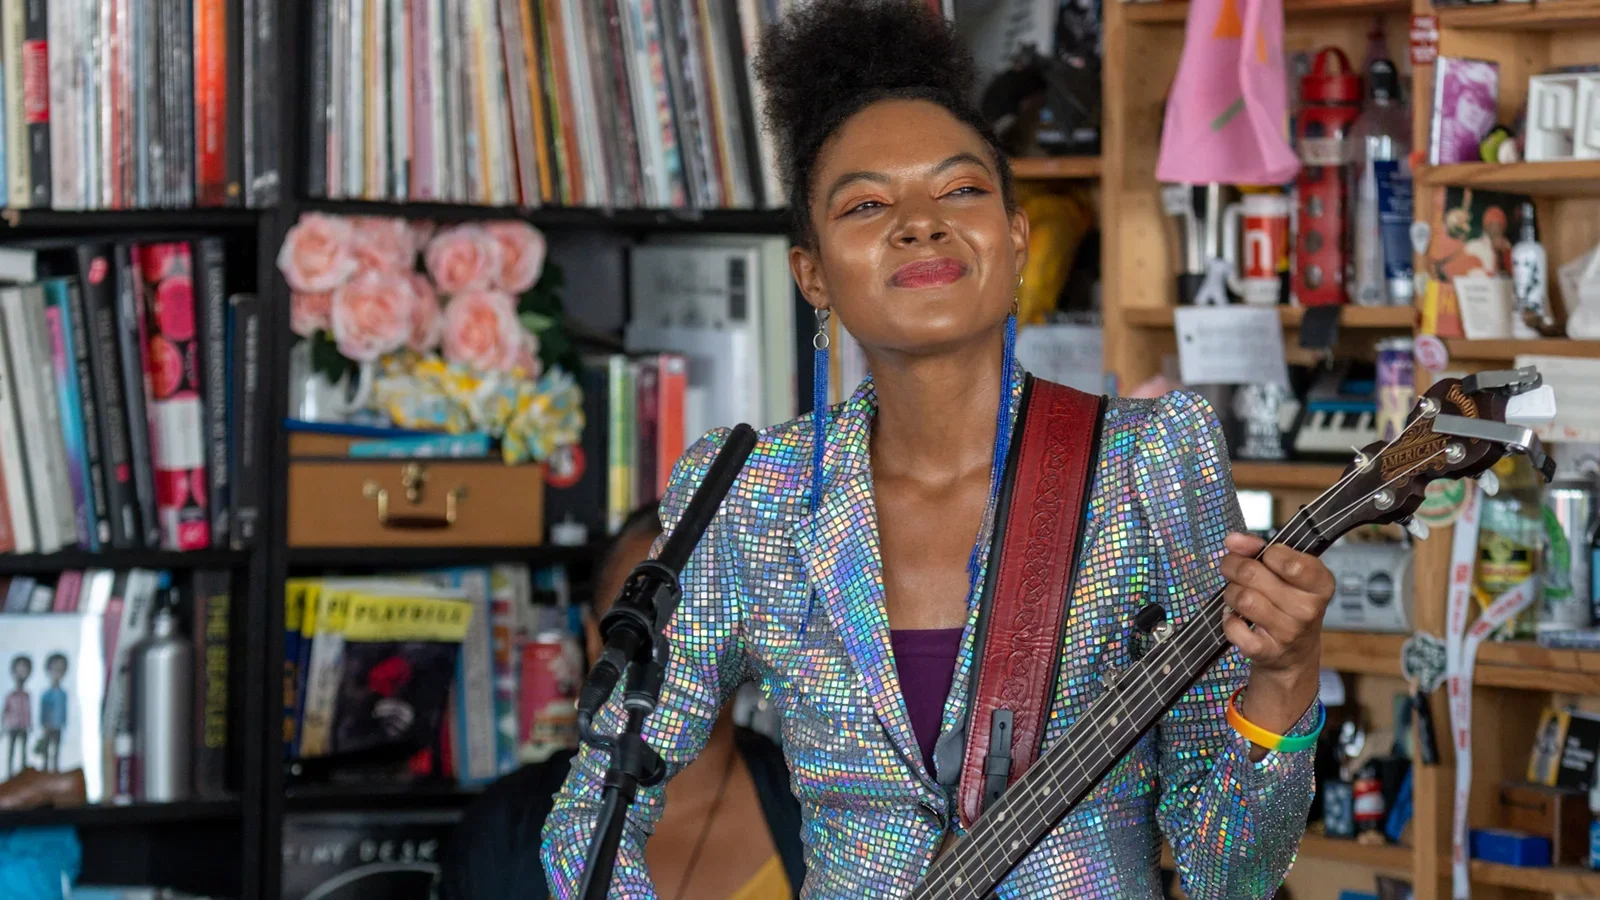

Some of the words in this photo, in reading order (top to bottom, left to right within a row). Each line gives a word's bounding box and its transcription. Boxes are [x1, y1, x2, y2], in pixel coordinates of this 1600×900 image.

[1245, 229, 1272, 268] n
[206, 594, 229, 638] THE
[355, 603, 462, 622] PLAYBILL
[204, 644, 229, 749] BEATLES
[359, 838, 438, 864] DESK
